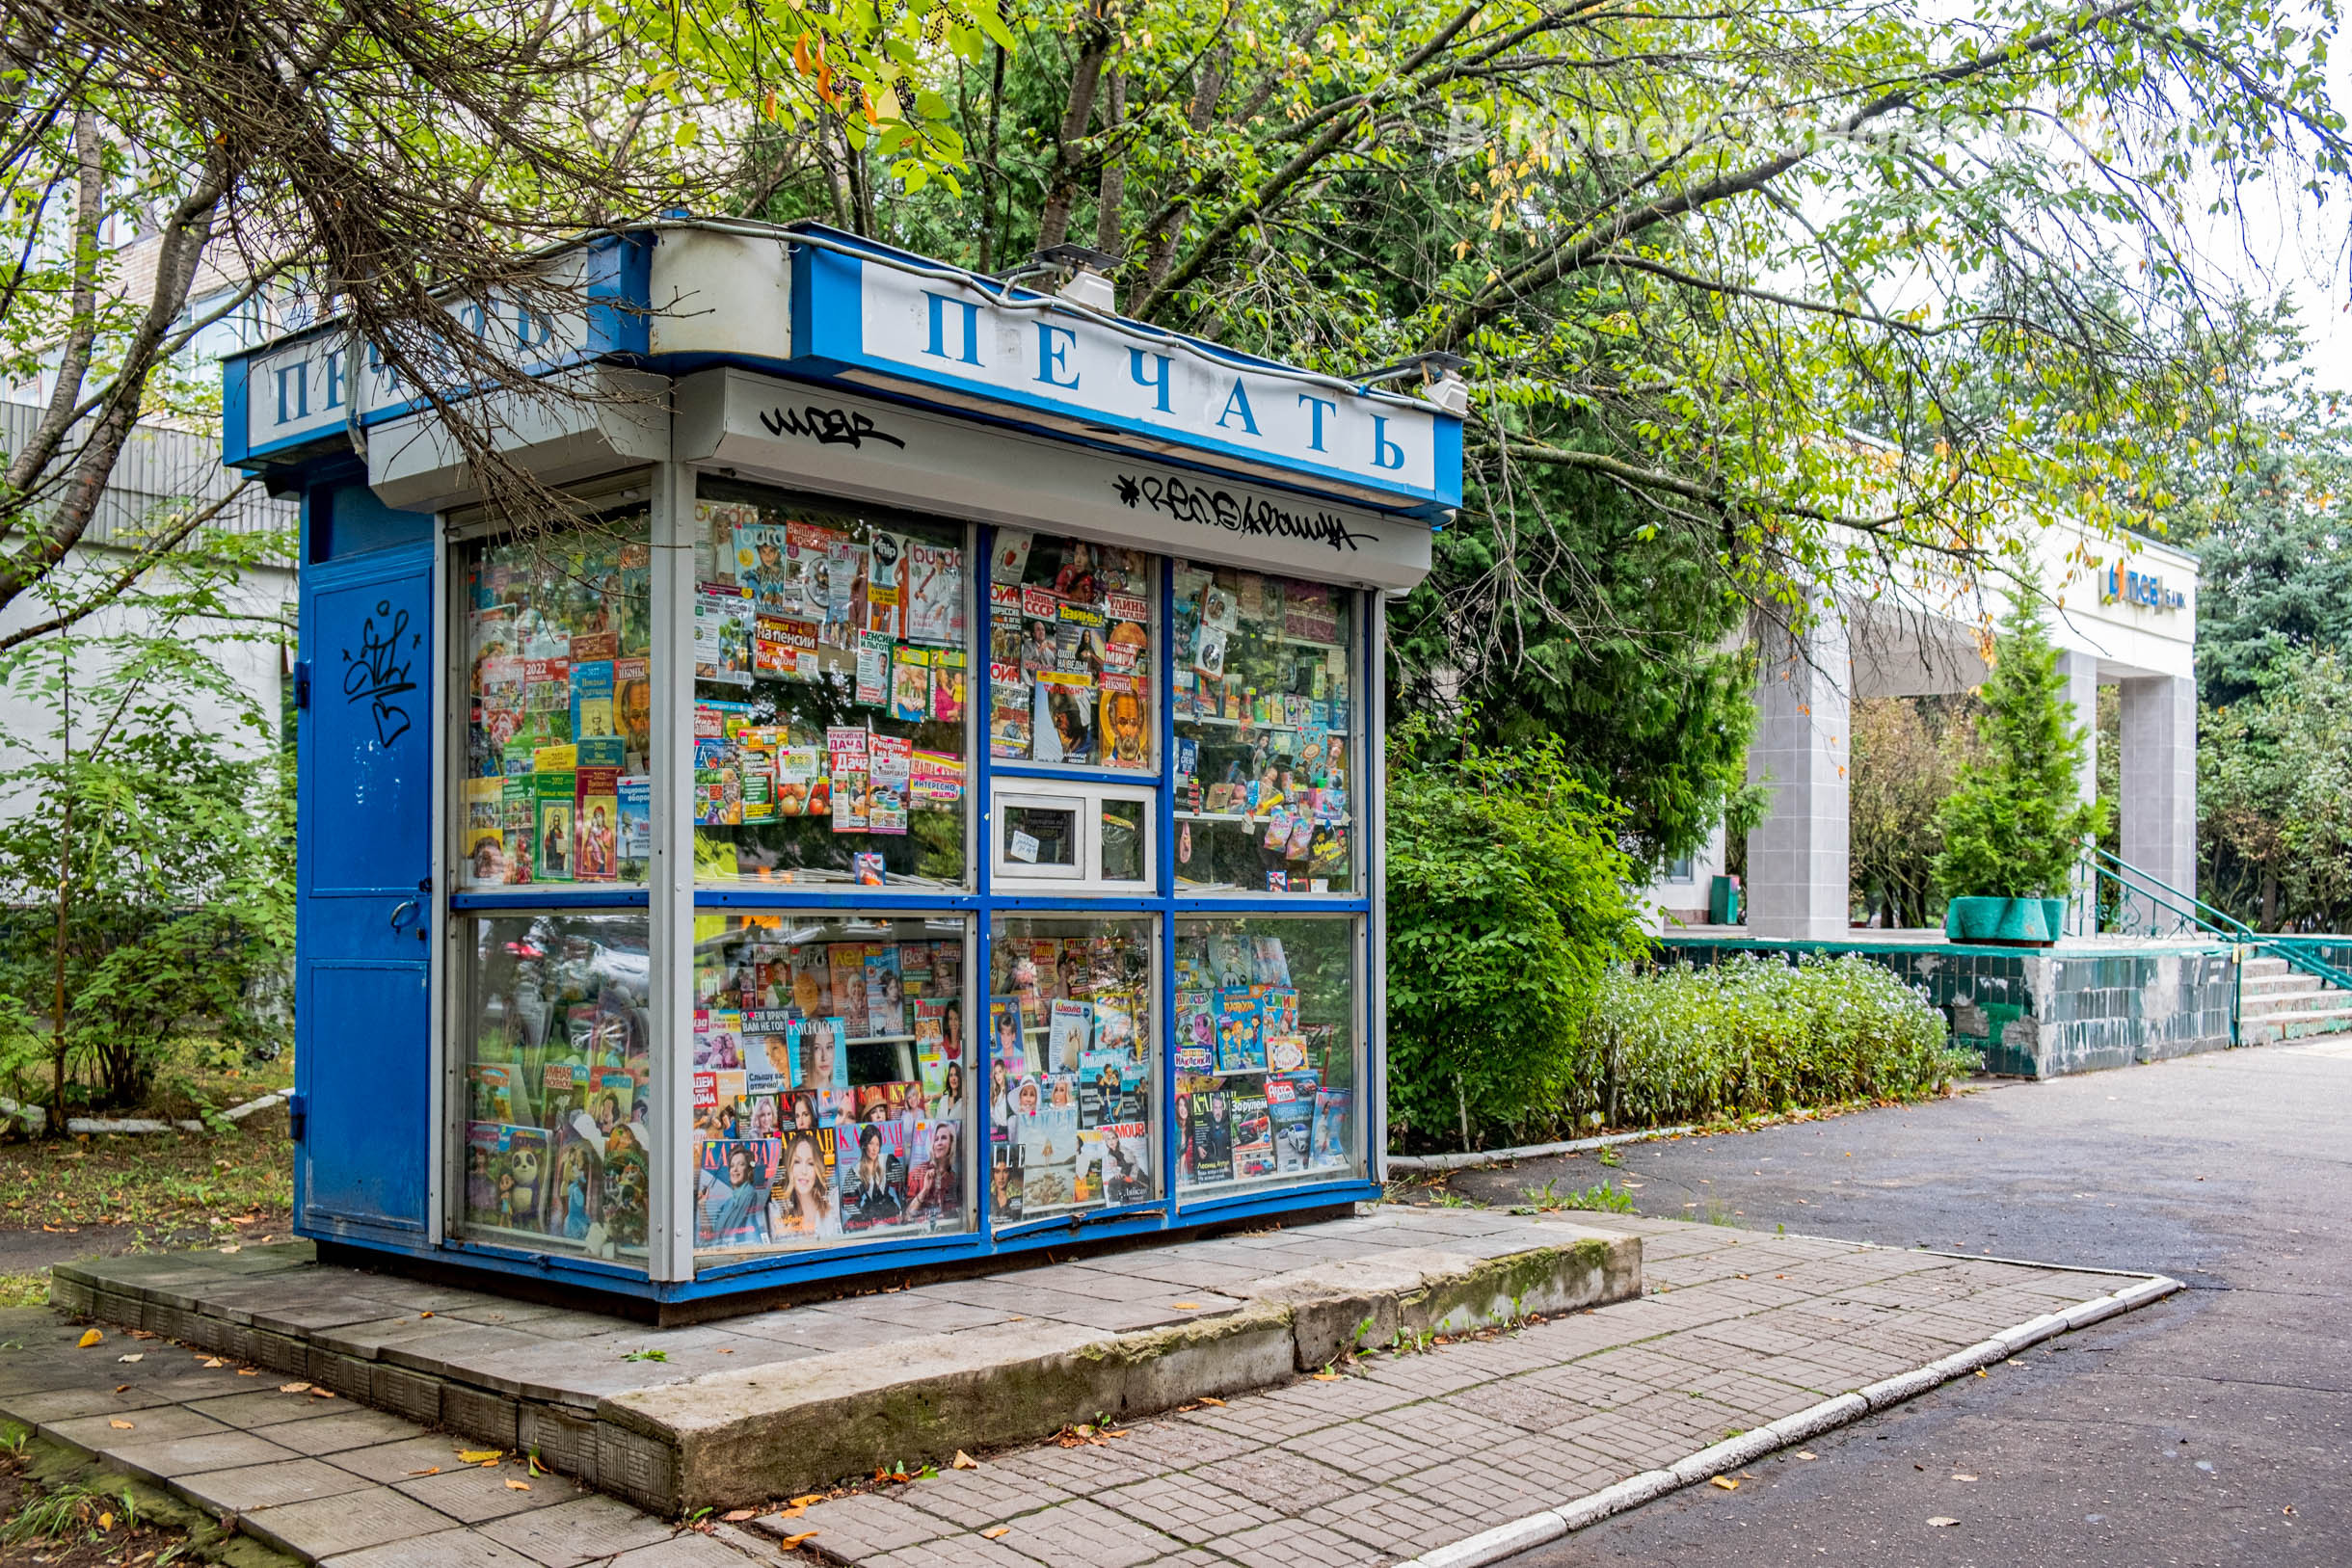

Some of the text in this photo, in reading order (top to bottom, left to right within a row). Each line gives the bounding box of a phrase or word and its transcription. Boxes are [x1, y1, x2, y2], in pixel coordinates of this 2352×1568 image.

[274, 288, 553, 426] ПЕЧТЬ
[920, 288, 1405, 471] ПЕЧАТЬ
[2127, 571, 2158, 606] ПСБ
[1024, 601, 1056, 618] СССР
[757, 626, 816, 650] На пенсии
[526, 662, 548, 675] 2022
[829, 739, 864, 751] ДАЧА
[913, 781, 956, 791] ИНТЕРЕСНО
[740, 1012, 748, 1021] О
[767, 1010, 789, 1021] ВРАЧИ
[1056, 1002, 1082, 1014] Школа
[742, 1022, 759, 1032] ВАМ
[761, 1022, 769, 1031] НЕ
[748, 1073, 773, 1083] Слышу
[1096, 1122, 1145, 1139] GMOUR
[704, 1141, 780, 1167] КАВАН
